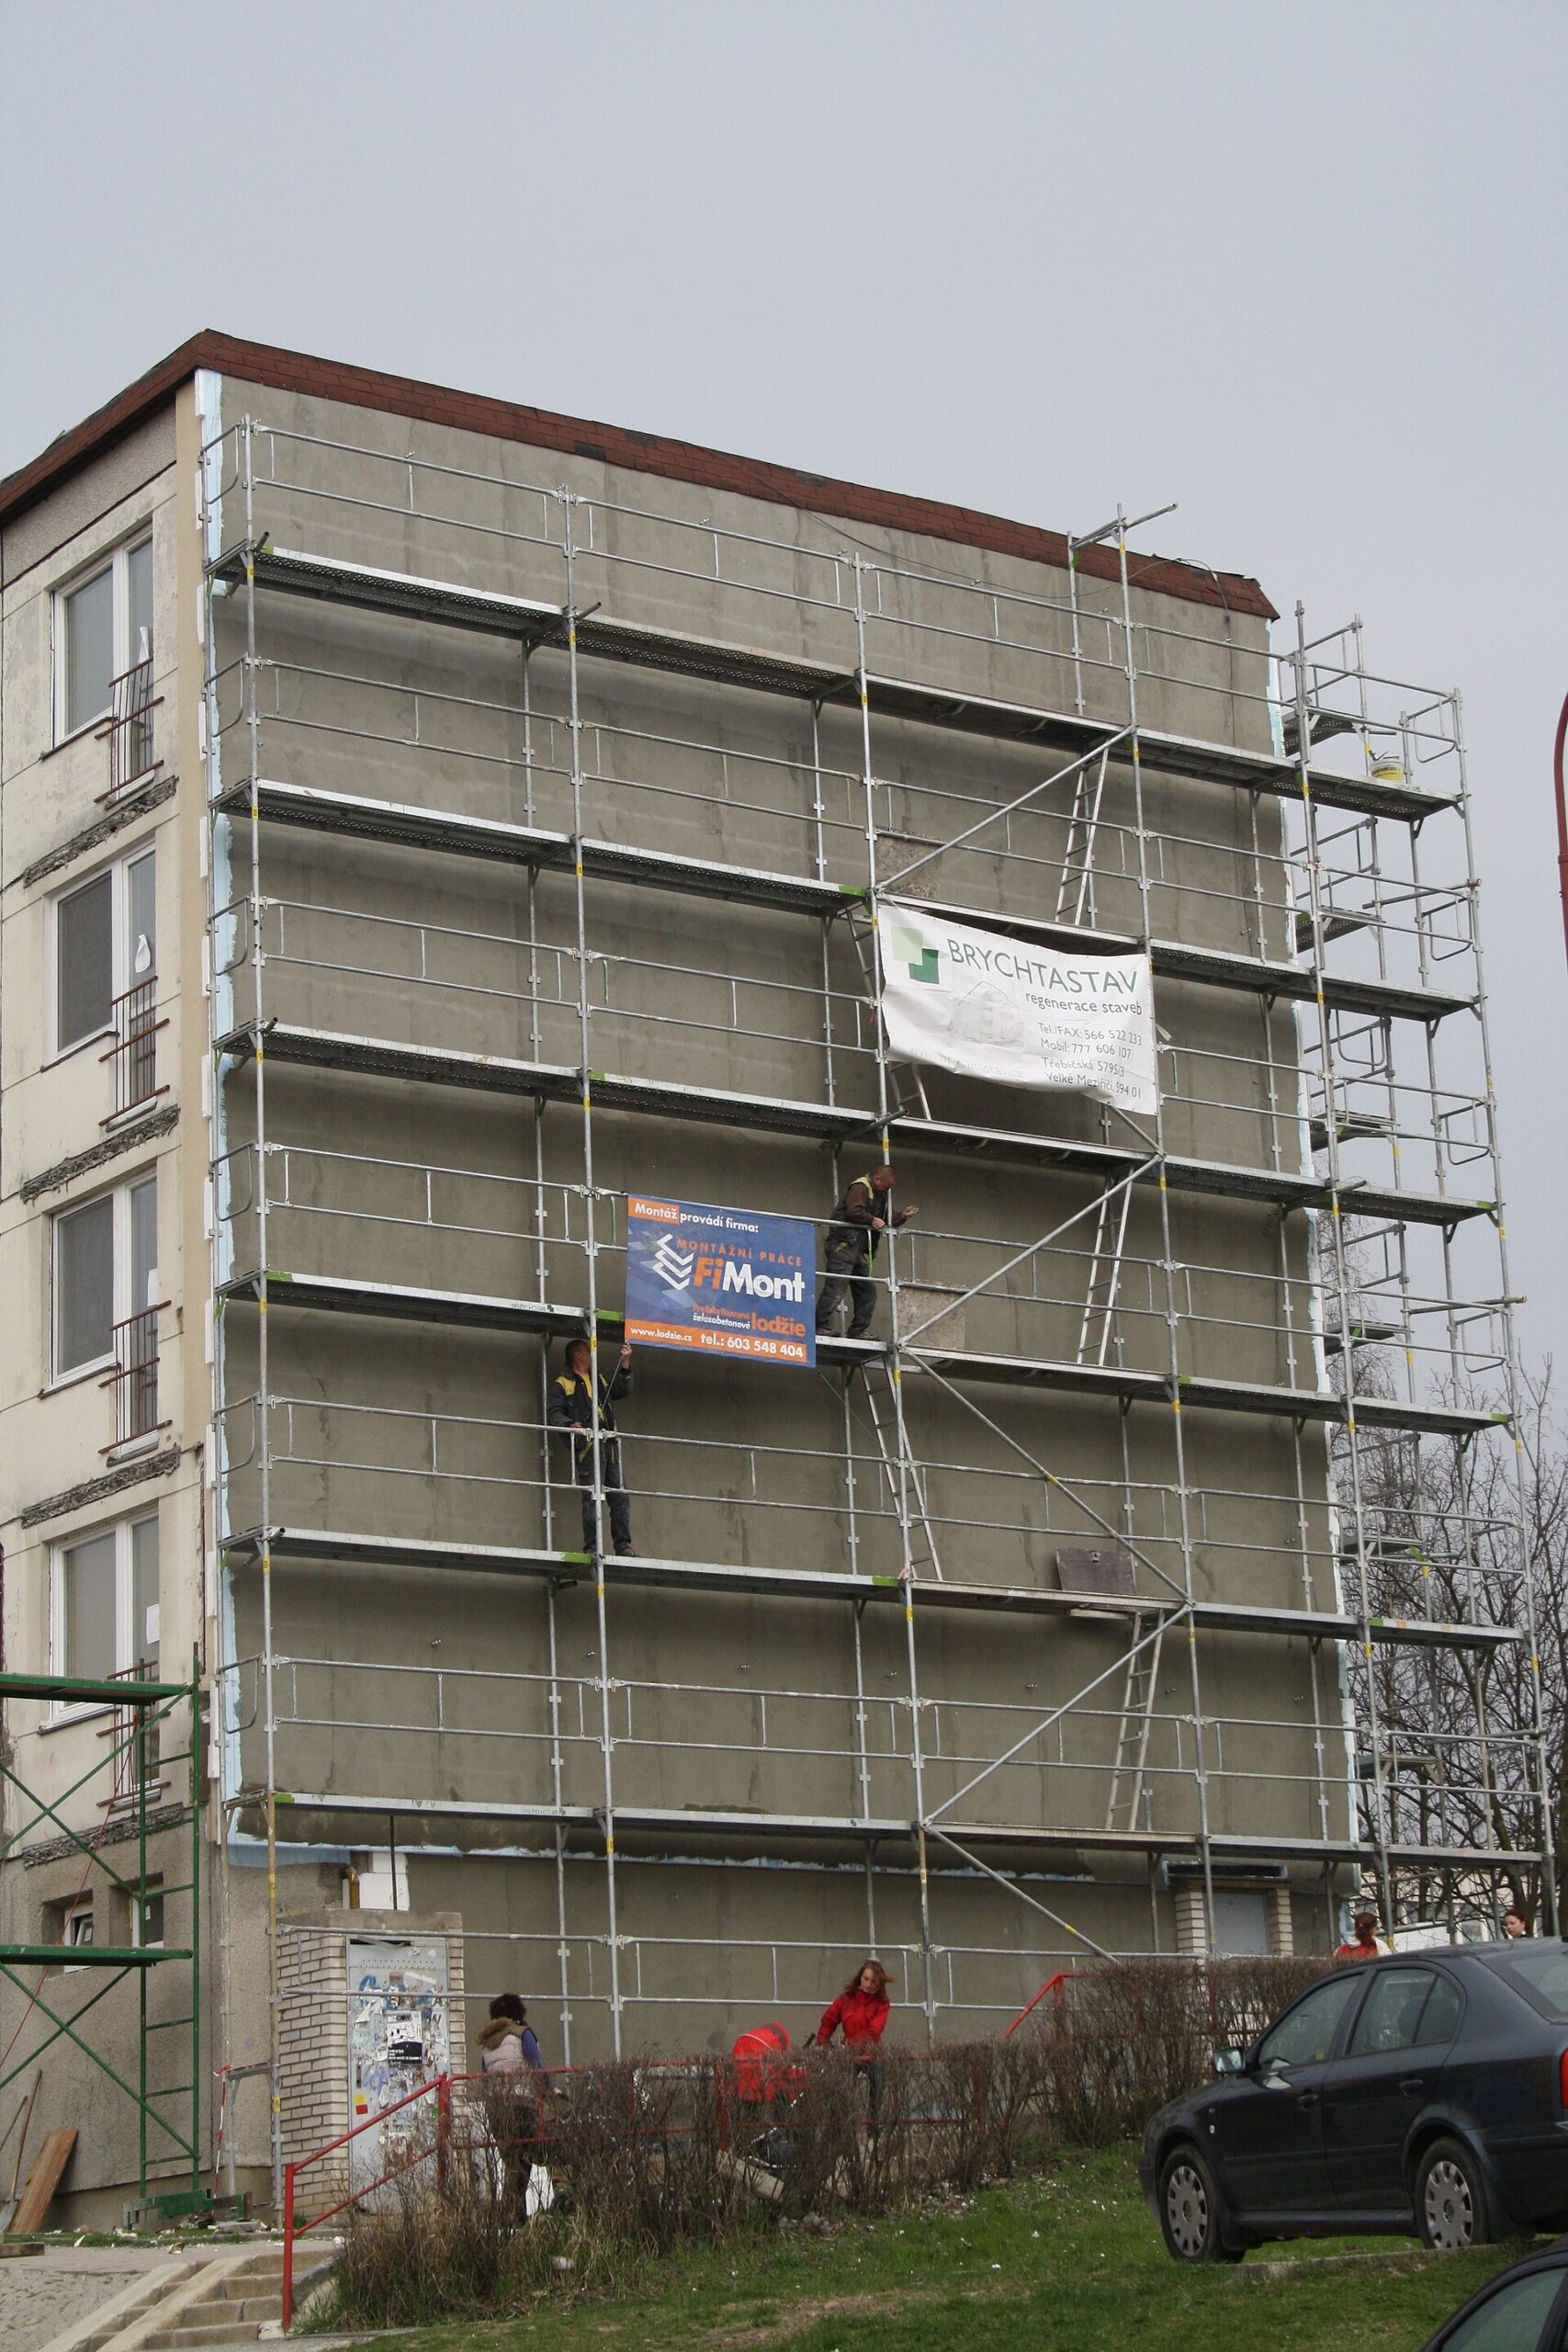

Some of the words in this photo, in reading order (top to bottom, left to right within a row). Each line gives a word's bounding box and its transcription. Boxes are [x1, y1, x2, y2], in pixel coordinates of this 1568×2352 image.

[946, 938, 1137, 993] BRYCHTASTAV
[1025, 993, 1098, 1012] regenerace
[1102, 1001, 1143, 1015] staveb
[1041, 1038, 1070, 1053] Mobil:
[1072, 1043, 1090, 1054] 777
[1096, 1045, 1115, 1055] 606
[1118, 1046, 1132, 1059] 107
[1084, 1030, 1105, 1040] 566
[1108, 1030, 1126, 1042] 522
[1129, 1032, 1142, 1046] 233
[1044, 1071, 1074, 1084] Velké
[1115, 1082, 1130, 1096] 594
[1131, 1087, 1142, 1099] 01
[635, 1203, 678, 1220] Montáž
[680, 1212, 724, 1227] provádí
[726, 1219, 759, 1233] firma:
[677, 1238, 752, 1260] MONTÁŽNÍ
[760, 1250, 803, 1266] PRÁCE
[694, 1256, 806, 1303] FiMont
[751, 1312, 807, 1337] lodžie
[630, 1327, 693, 1342] www.lodzie.cz
[701, 1332, 725, 1347] tel.:
[727, 1335, 750, 1350] 603
[753, 1339, 777, 1354] 548
[779, 1342, 804, 1358] 404
